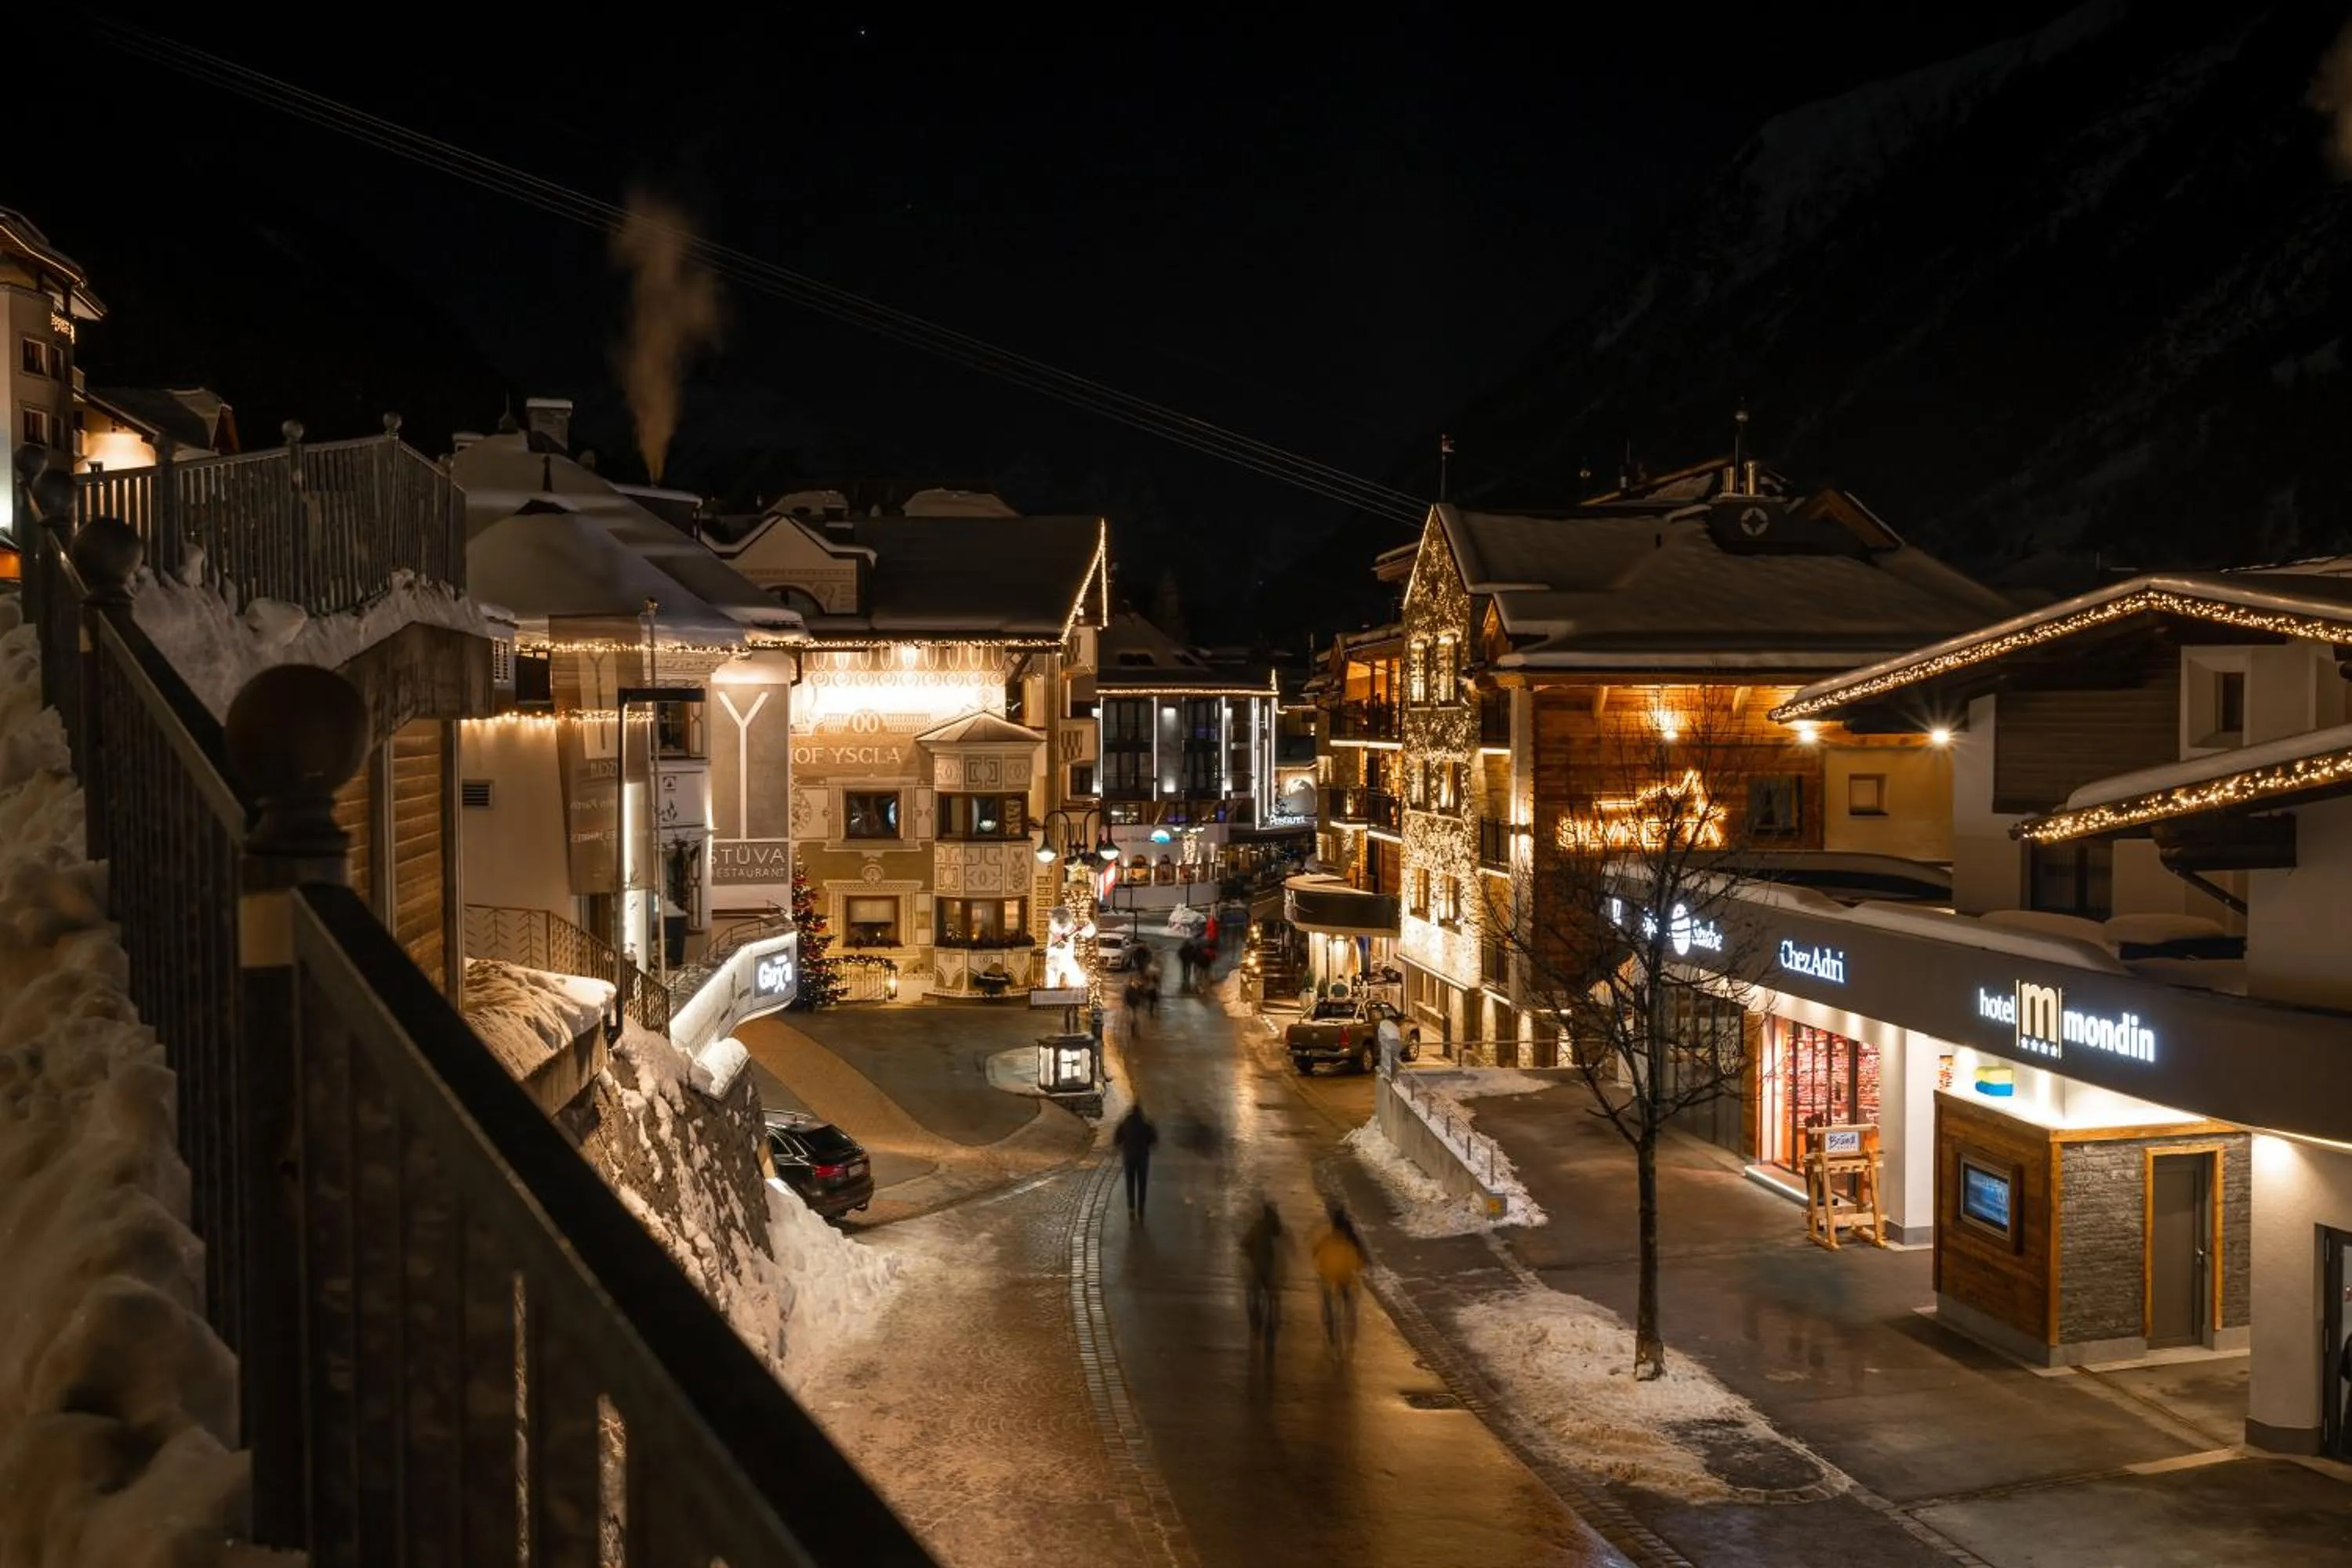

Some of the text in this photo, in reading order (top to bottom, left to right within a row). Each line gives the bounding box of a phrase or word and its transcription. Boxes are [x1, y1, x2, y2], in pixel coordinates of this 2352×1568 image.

[829, 747, 902, 764] YSCLA
[712, 867, 785, 878] ESTAURANT
[1979, 987, 2016, 1025] hotel
[2063, 1010, 2155, 1062] mondin
